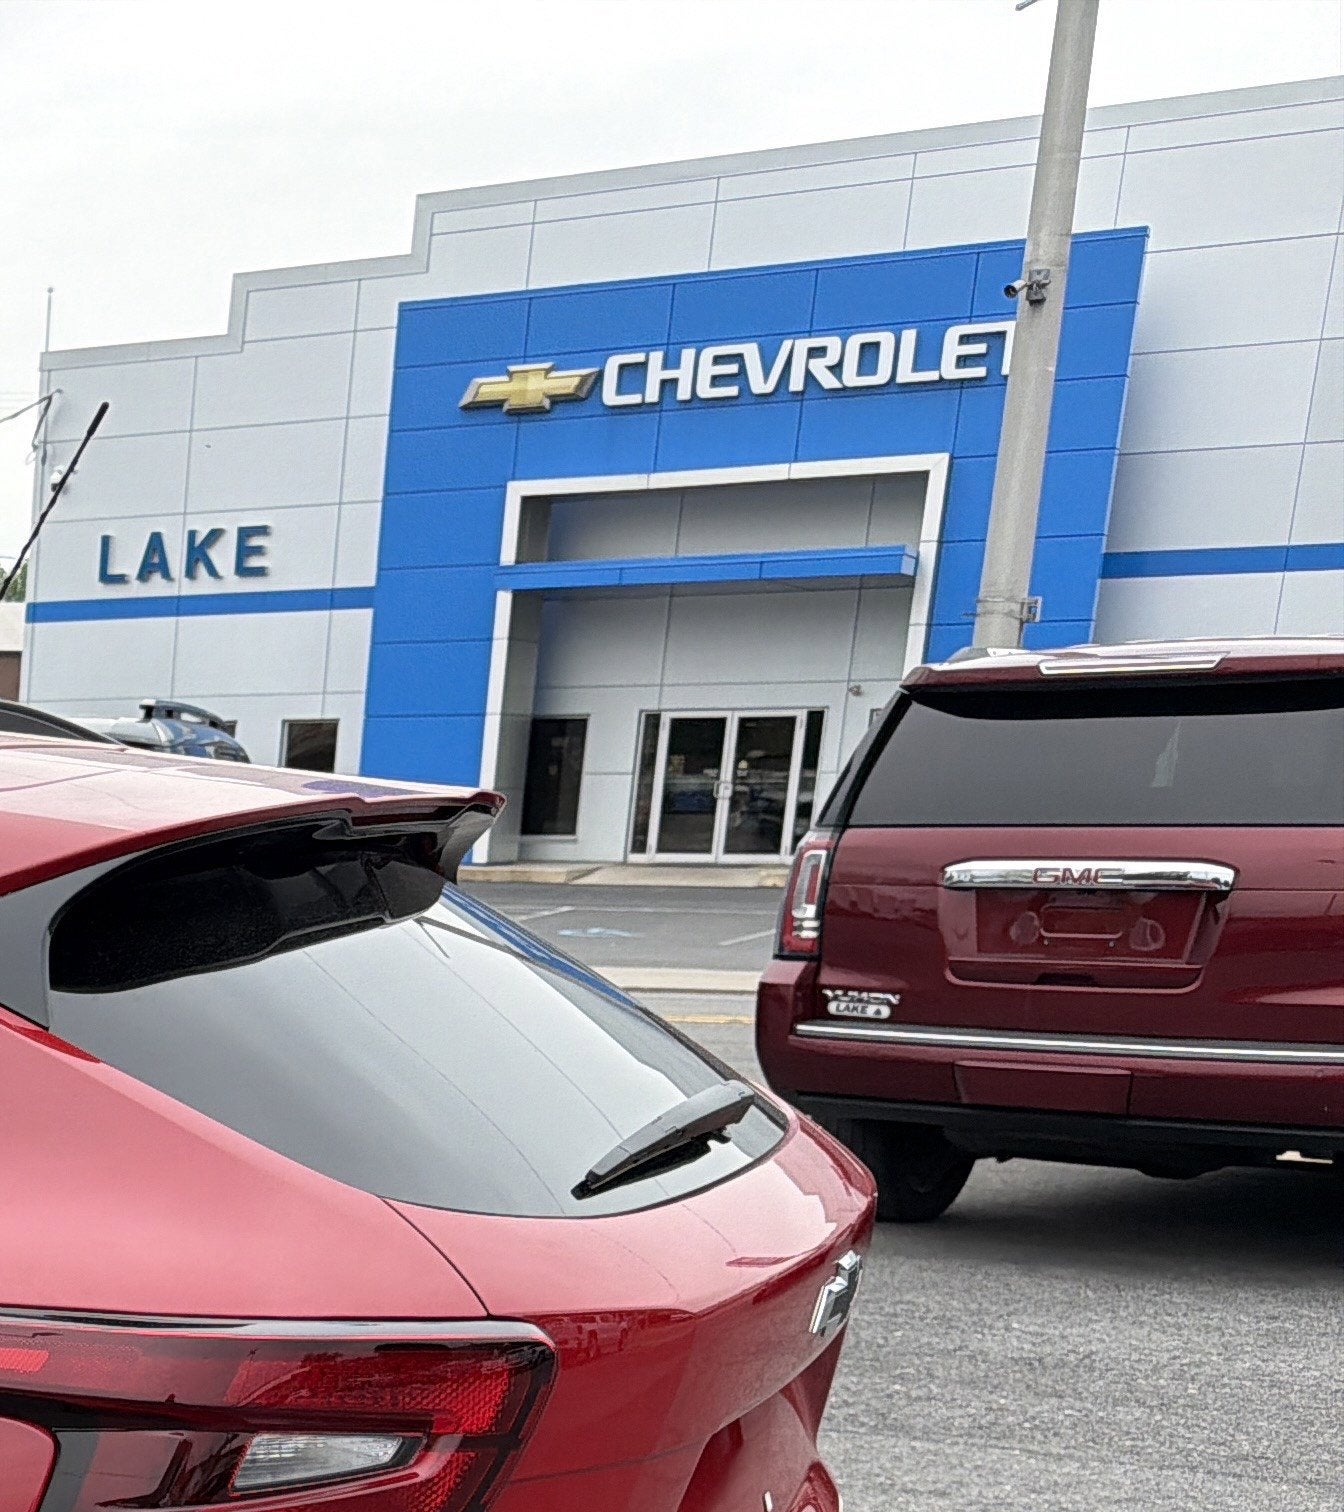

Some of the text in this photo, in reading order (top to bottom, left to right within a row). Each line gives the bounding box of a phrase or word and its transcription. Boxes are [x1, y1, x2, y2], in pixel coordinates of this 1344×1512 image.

[98, 524, 272, 585] LAKE
[1032, 867, 1124, 885] GMC
[835, 1003, 868, 1015] LAKE
